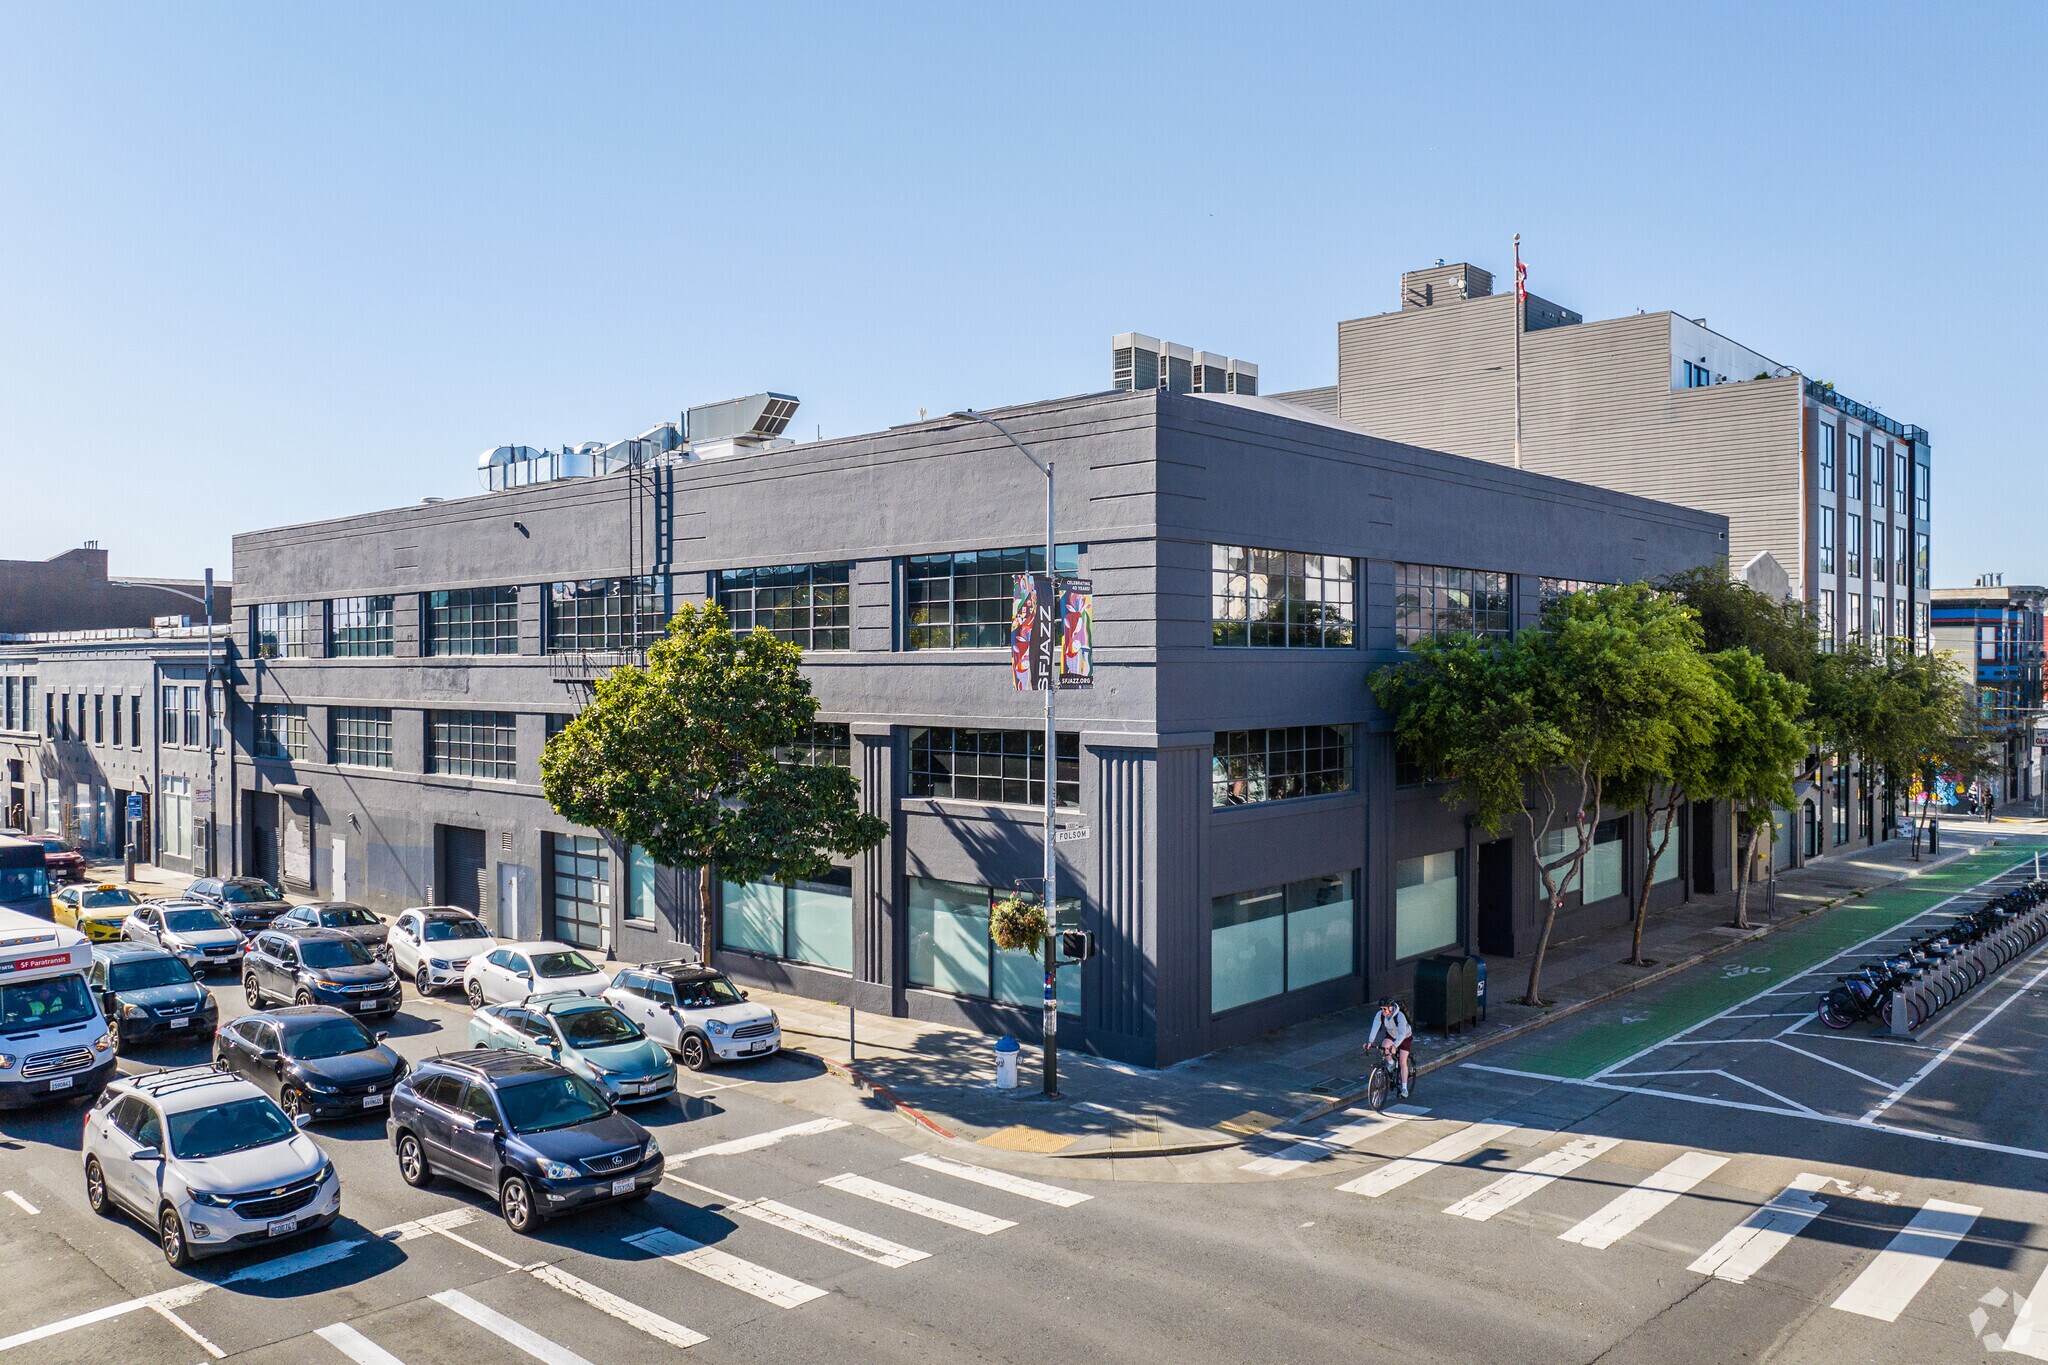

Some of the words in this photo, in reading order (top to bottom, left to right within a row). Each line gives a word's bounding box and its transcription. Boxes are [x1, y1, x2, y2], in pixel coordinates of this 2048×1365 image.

[1038, 606, 1051, 690] SFJAZZ
[1060, 831, 1087, 840] FOLSOM
[20, 961, 29, 969] SF
[30, 956, 66, 967] Paratransit
